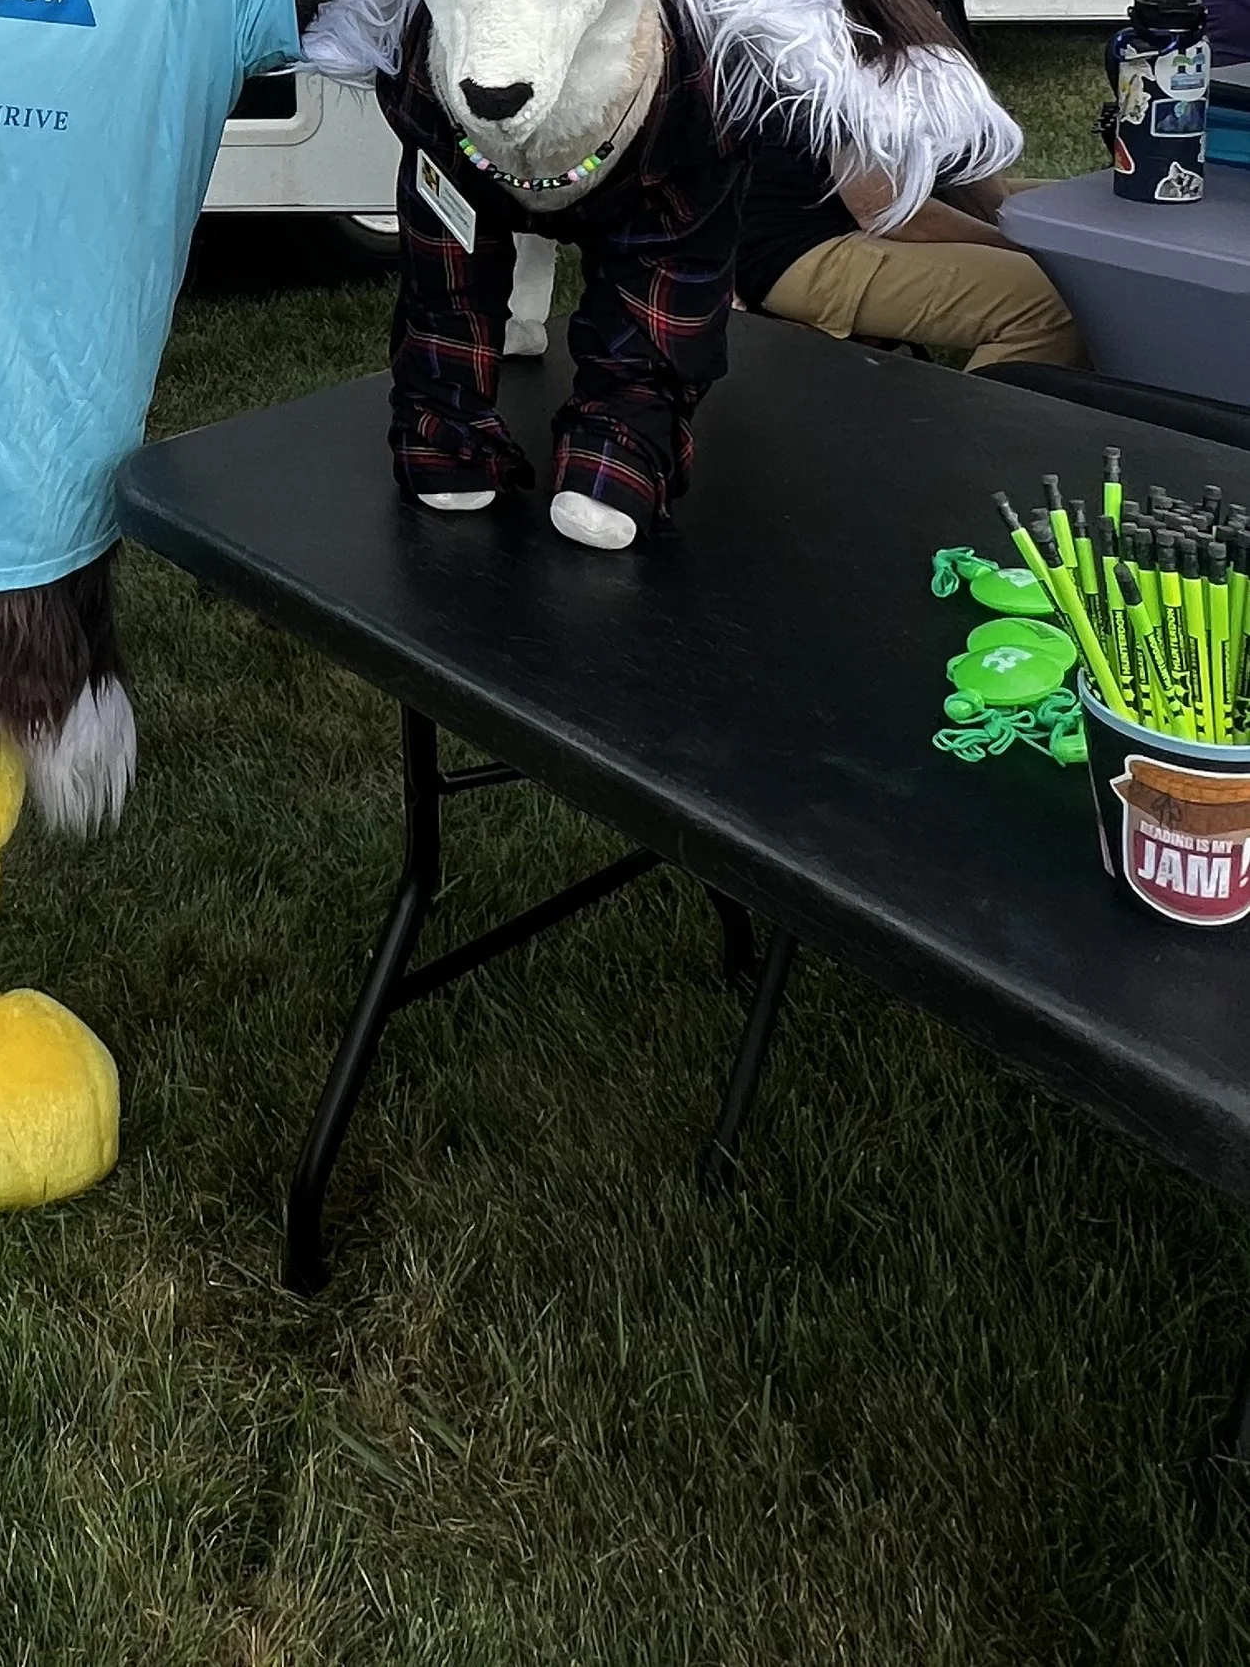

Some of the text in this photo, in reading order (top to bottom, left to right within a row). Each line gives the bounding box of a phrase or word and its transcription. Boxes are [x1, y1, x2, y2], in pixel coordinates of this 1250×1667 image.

[1139, 819, 1233, 854] READING IS MY
